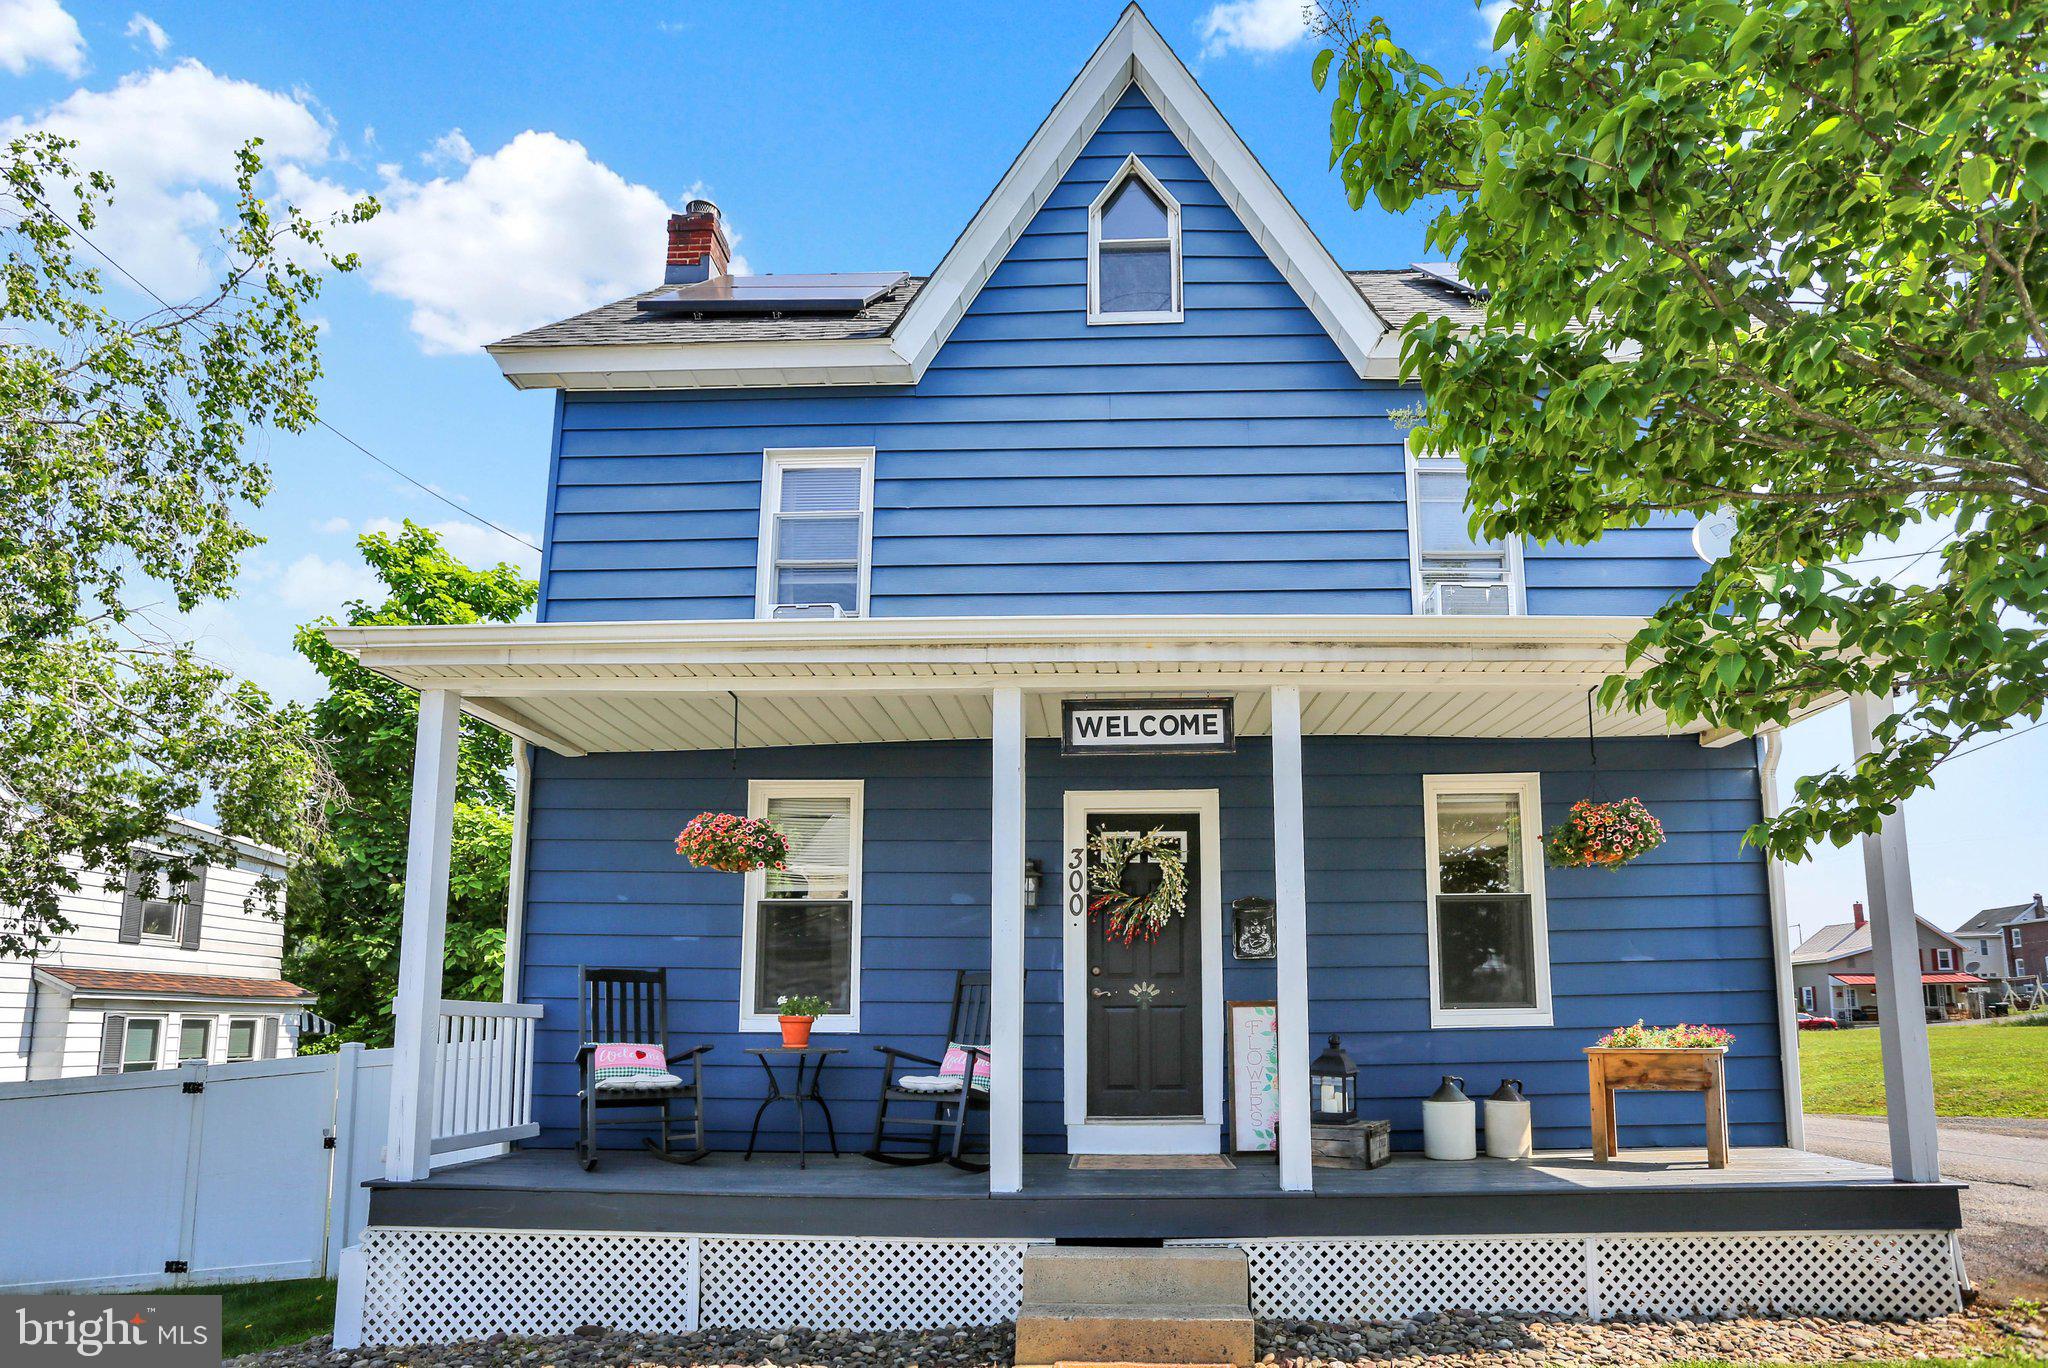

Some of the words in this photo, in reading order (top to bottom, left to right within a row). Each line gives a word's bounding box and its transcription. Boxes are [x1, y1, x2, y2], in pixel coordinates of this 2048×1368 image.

[1075, 713, 1218, 738] WELCOME
[1068, 848, 1085, 917] 300
[599, 1047, 661, 1063] Welcme
[1245, 1019, 1264, 1127] FLOWERS
